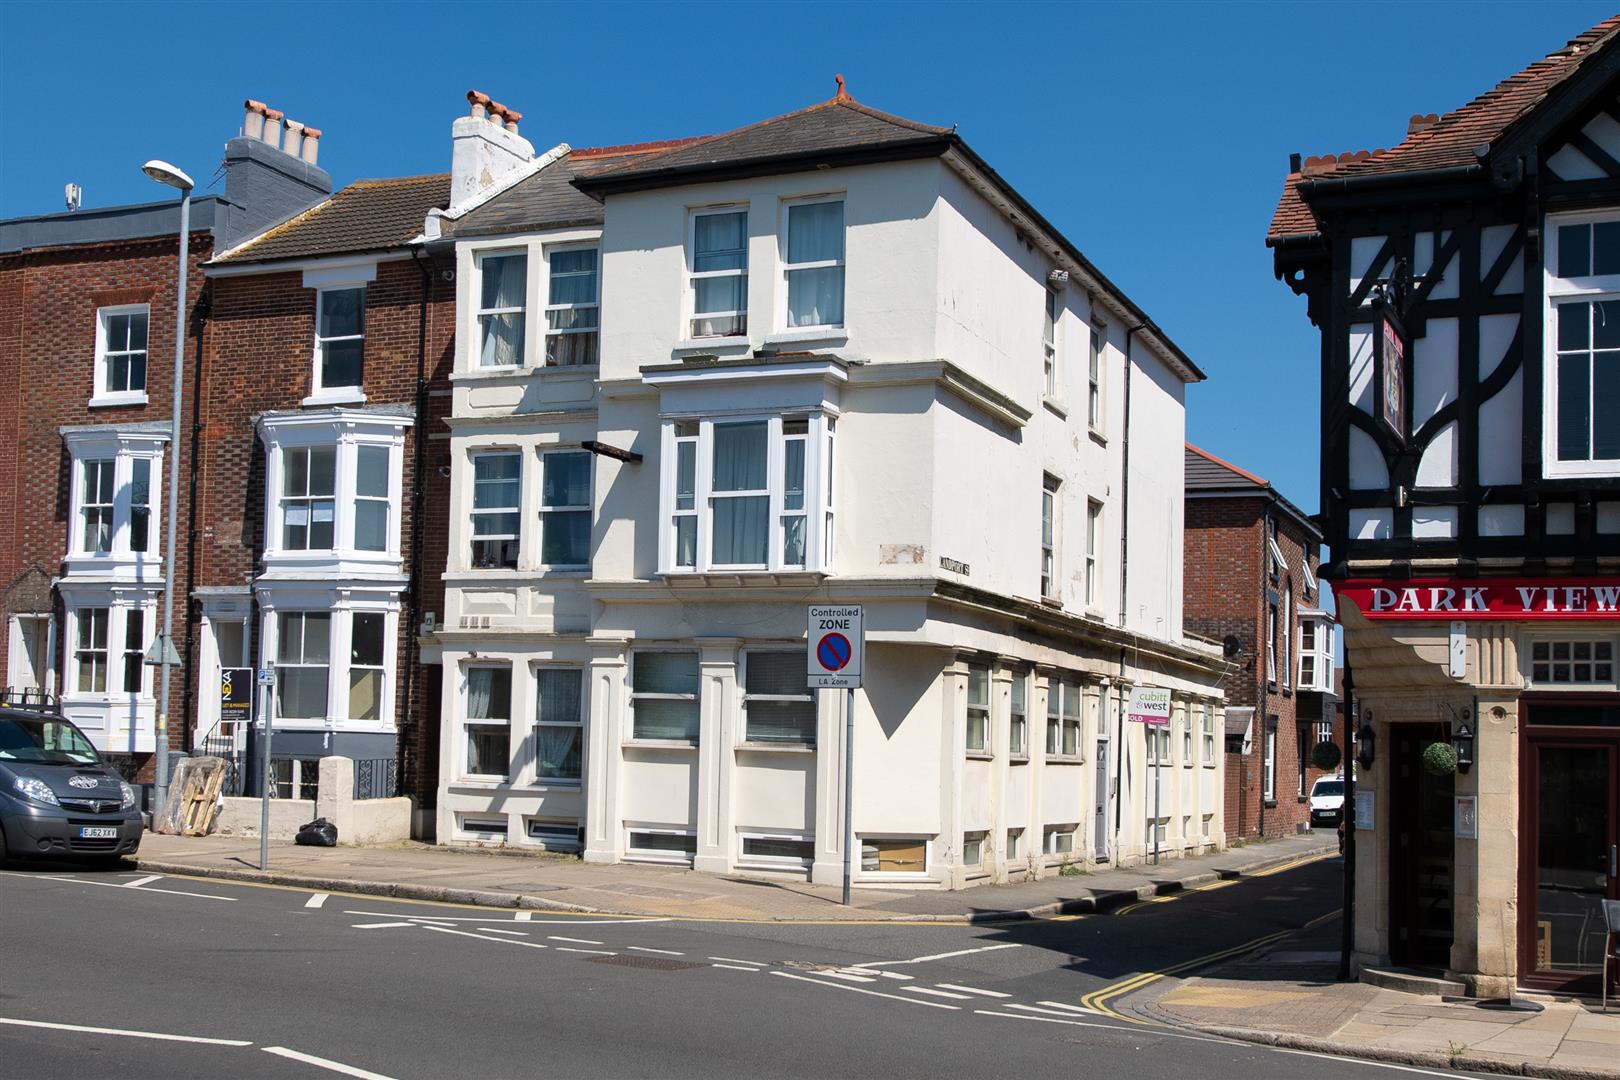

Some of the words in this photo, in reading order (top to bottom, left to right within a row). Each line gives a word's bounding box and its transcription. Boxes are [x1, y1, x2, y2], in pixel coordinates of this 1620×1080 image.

[1370, 587, 1490, 612] PARK
[1515, 587, 1620, 612] VIEW
[811, 608, 859, 617] Controlled
[819, 619, 850, 630] ZONE
[1139, 691, 1168, 702] cubitt
[1143, 702, 1167, 711] west
